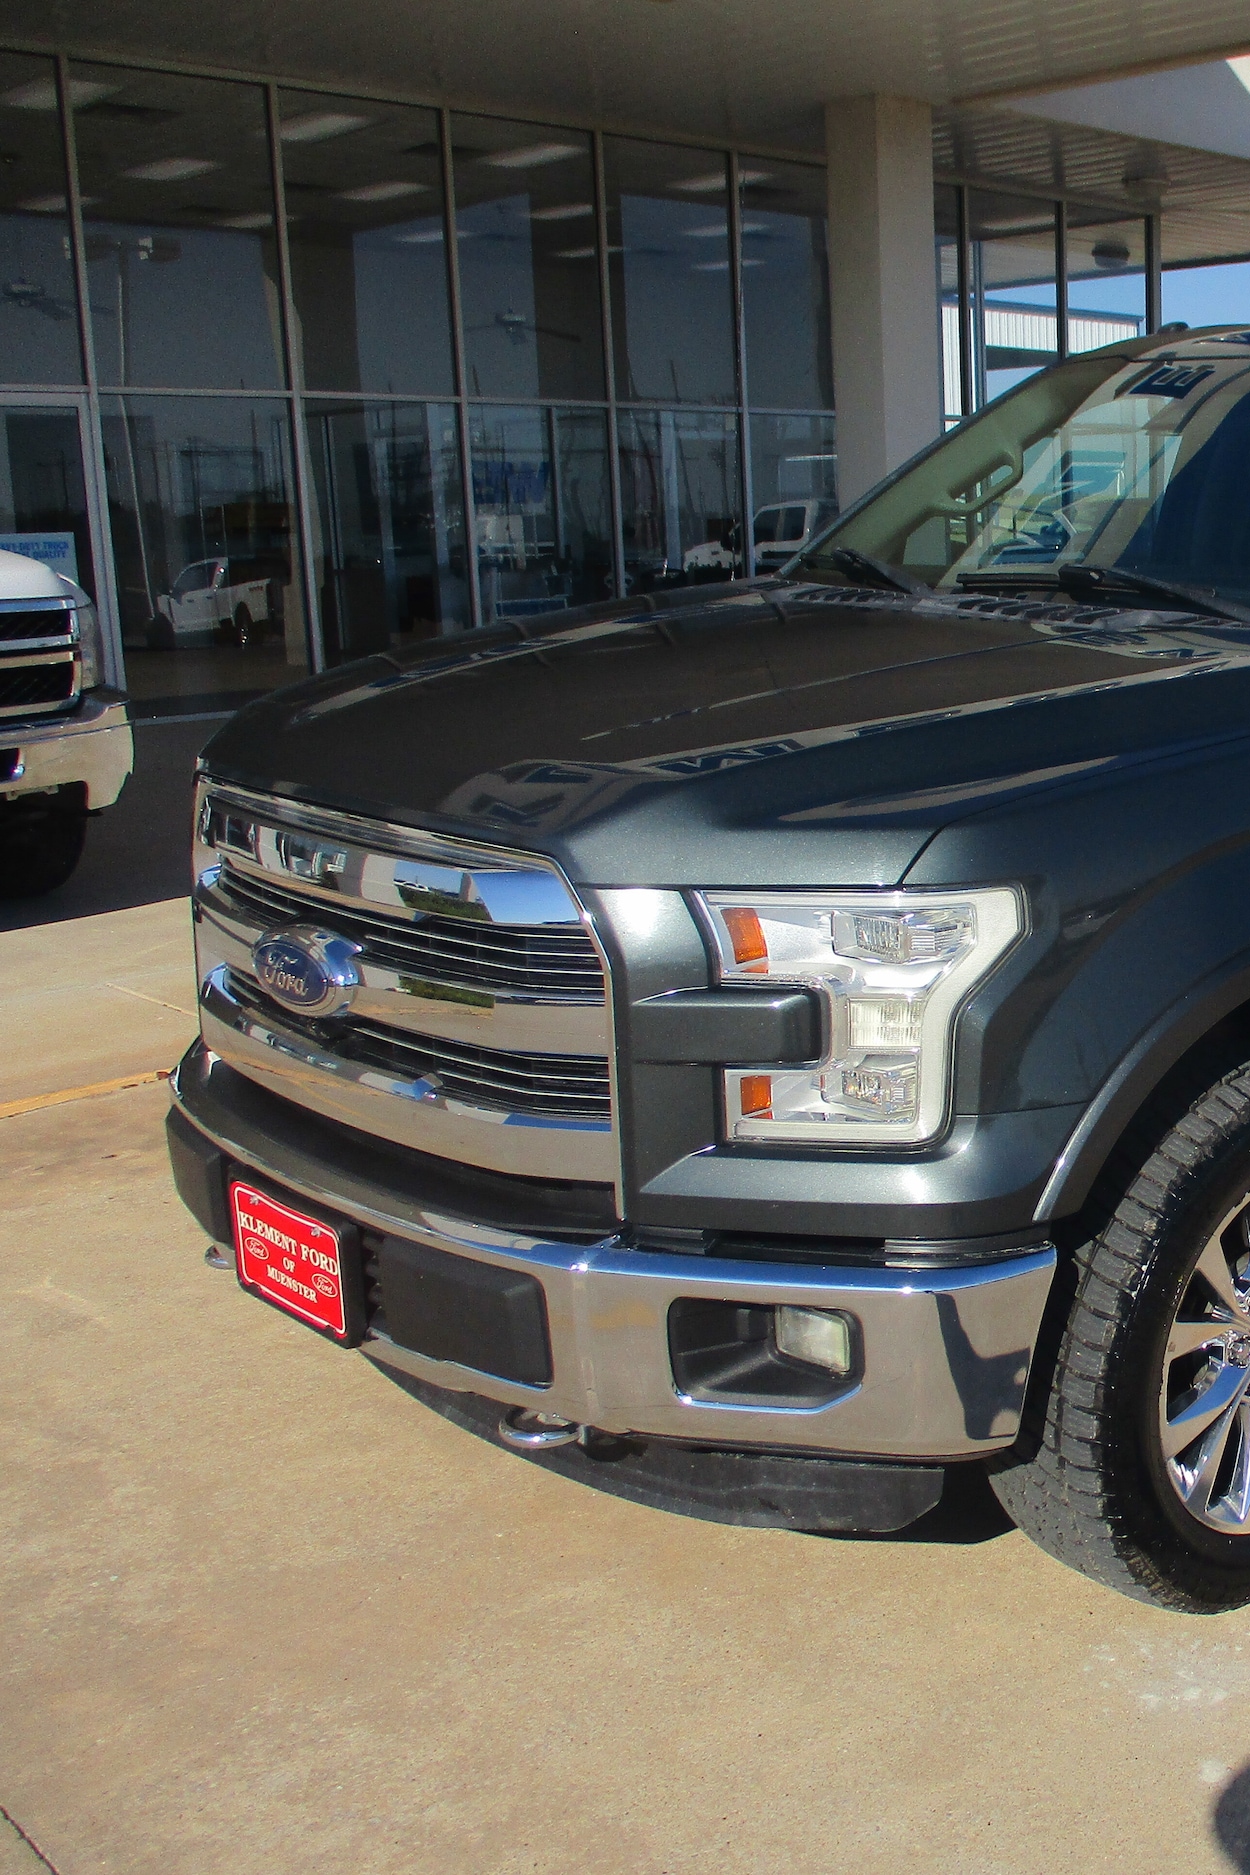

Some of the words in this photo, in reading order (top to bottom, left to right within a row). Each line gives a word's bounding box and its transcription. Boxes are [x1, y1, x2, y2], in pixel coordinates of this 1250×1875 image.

[264, 951, 309, 996] Ford
[239, 1211, 298, 1256] KLEMENT
[300, 1243, 338, 1276] FORD
[267, 1265, 318, 1303] MUENSTER
[283, 1257, 296, 1273] OF
